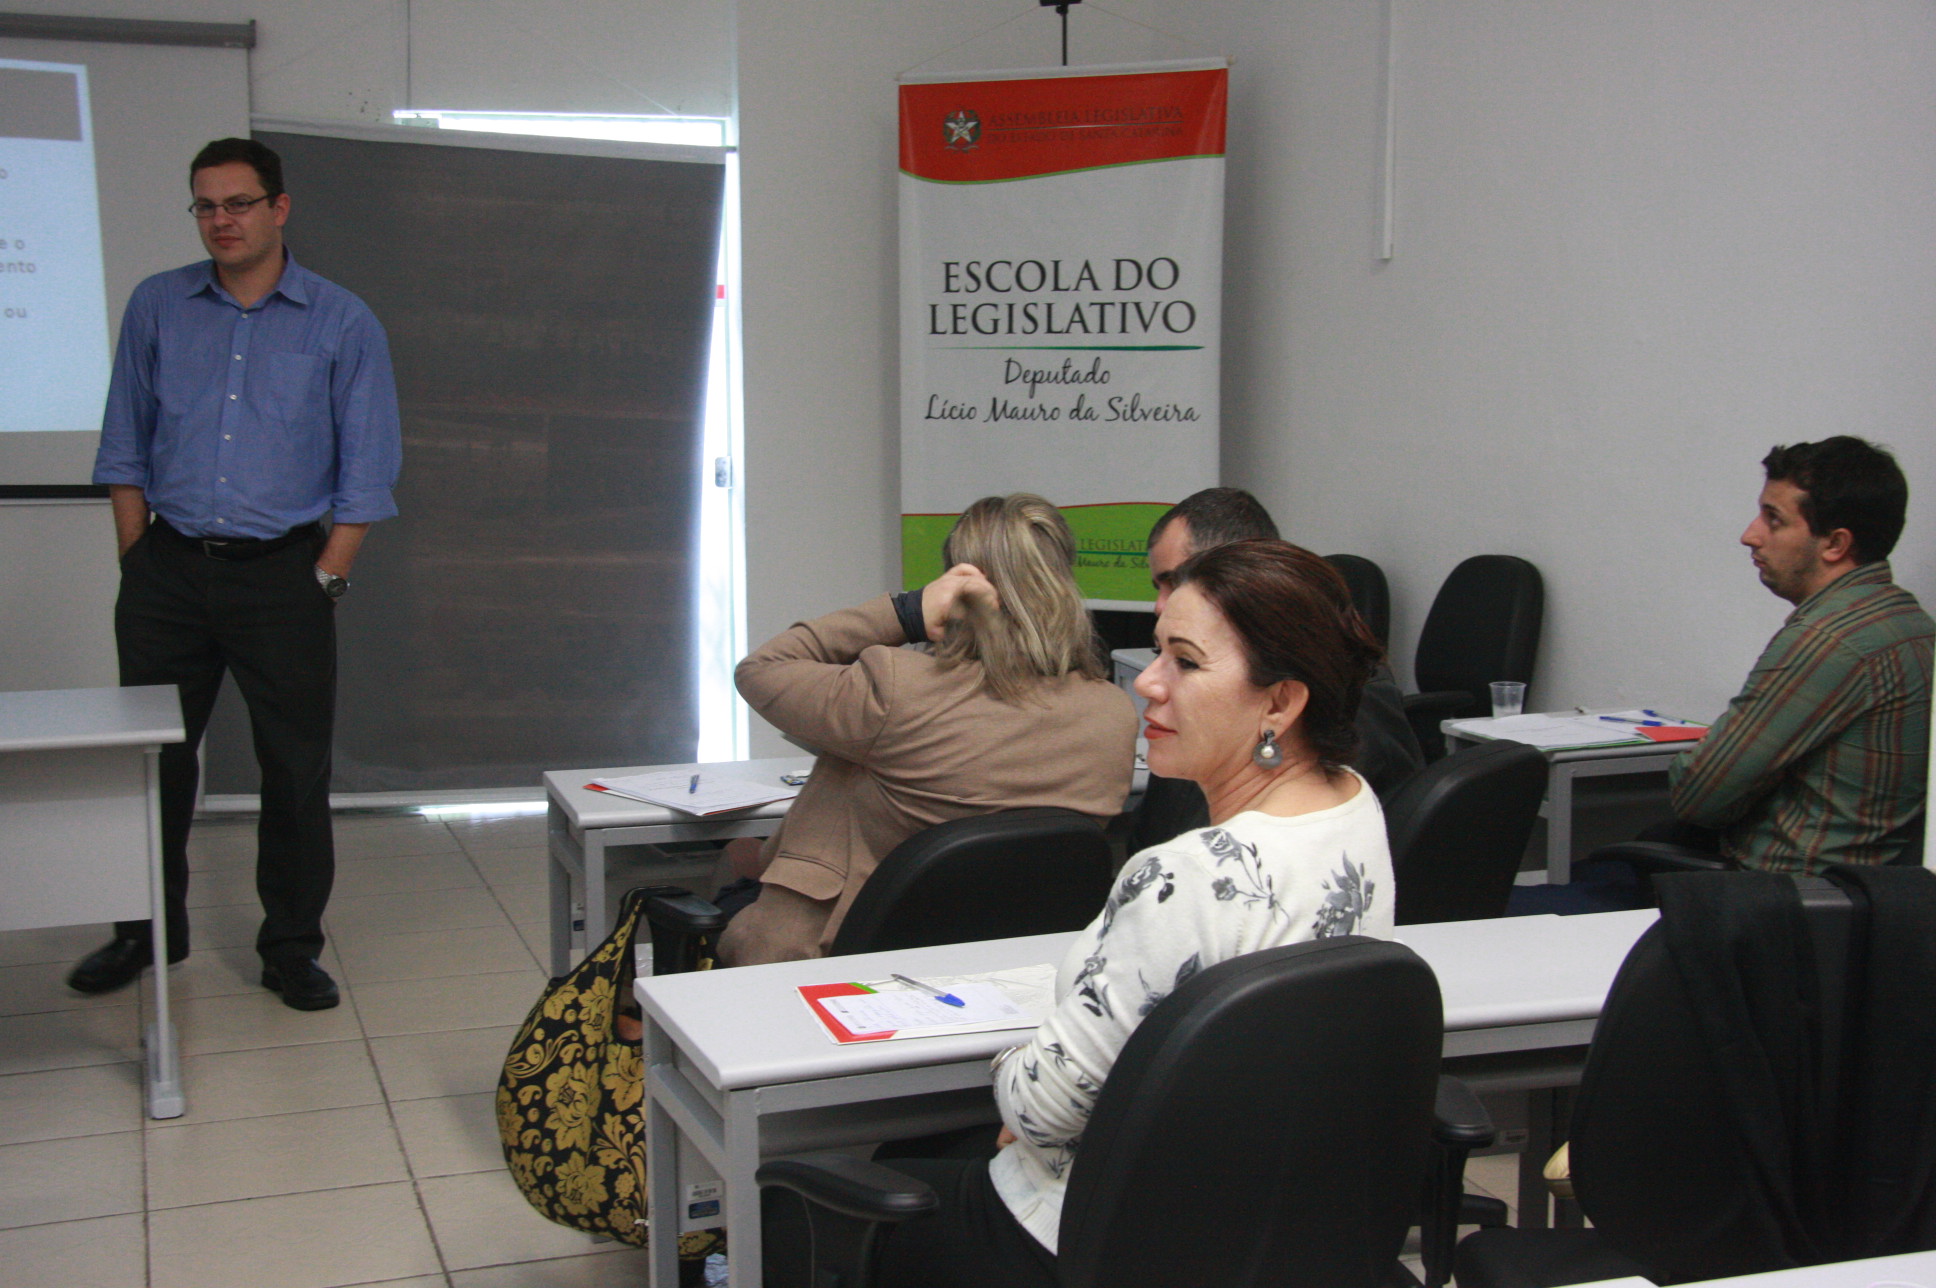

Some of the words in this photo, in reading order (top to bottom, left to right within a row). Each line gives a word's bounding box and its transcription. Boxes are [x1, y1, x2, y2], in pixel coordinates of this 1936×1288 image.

[1085, 106, 1185, 123] LEGISLATIVA
[942, 259, 1101, 293] ESCOLA
[1112, 257, 1180, 291] DO
[928, 300, 1197, 335] LEGISLATIVO
[1004, 357, 1111, 399] Deputado
[924, 394, 978, 421] Lício
[983, 397, 1061, 423] Mauro
[1069, 394, 1100, 422] da
[1105, 393, 1200, 423] Silveira
[1080, 538, 1146, 552] LEGISLAT
